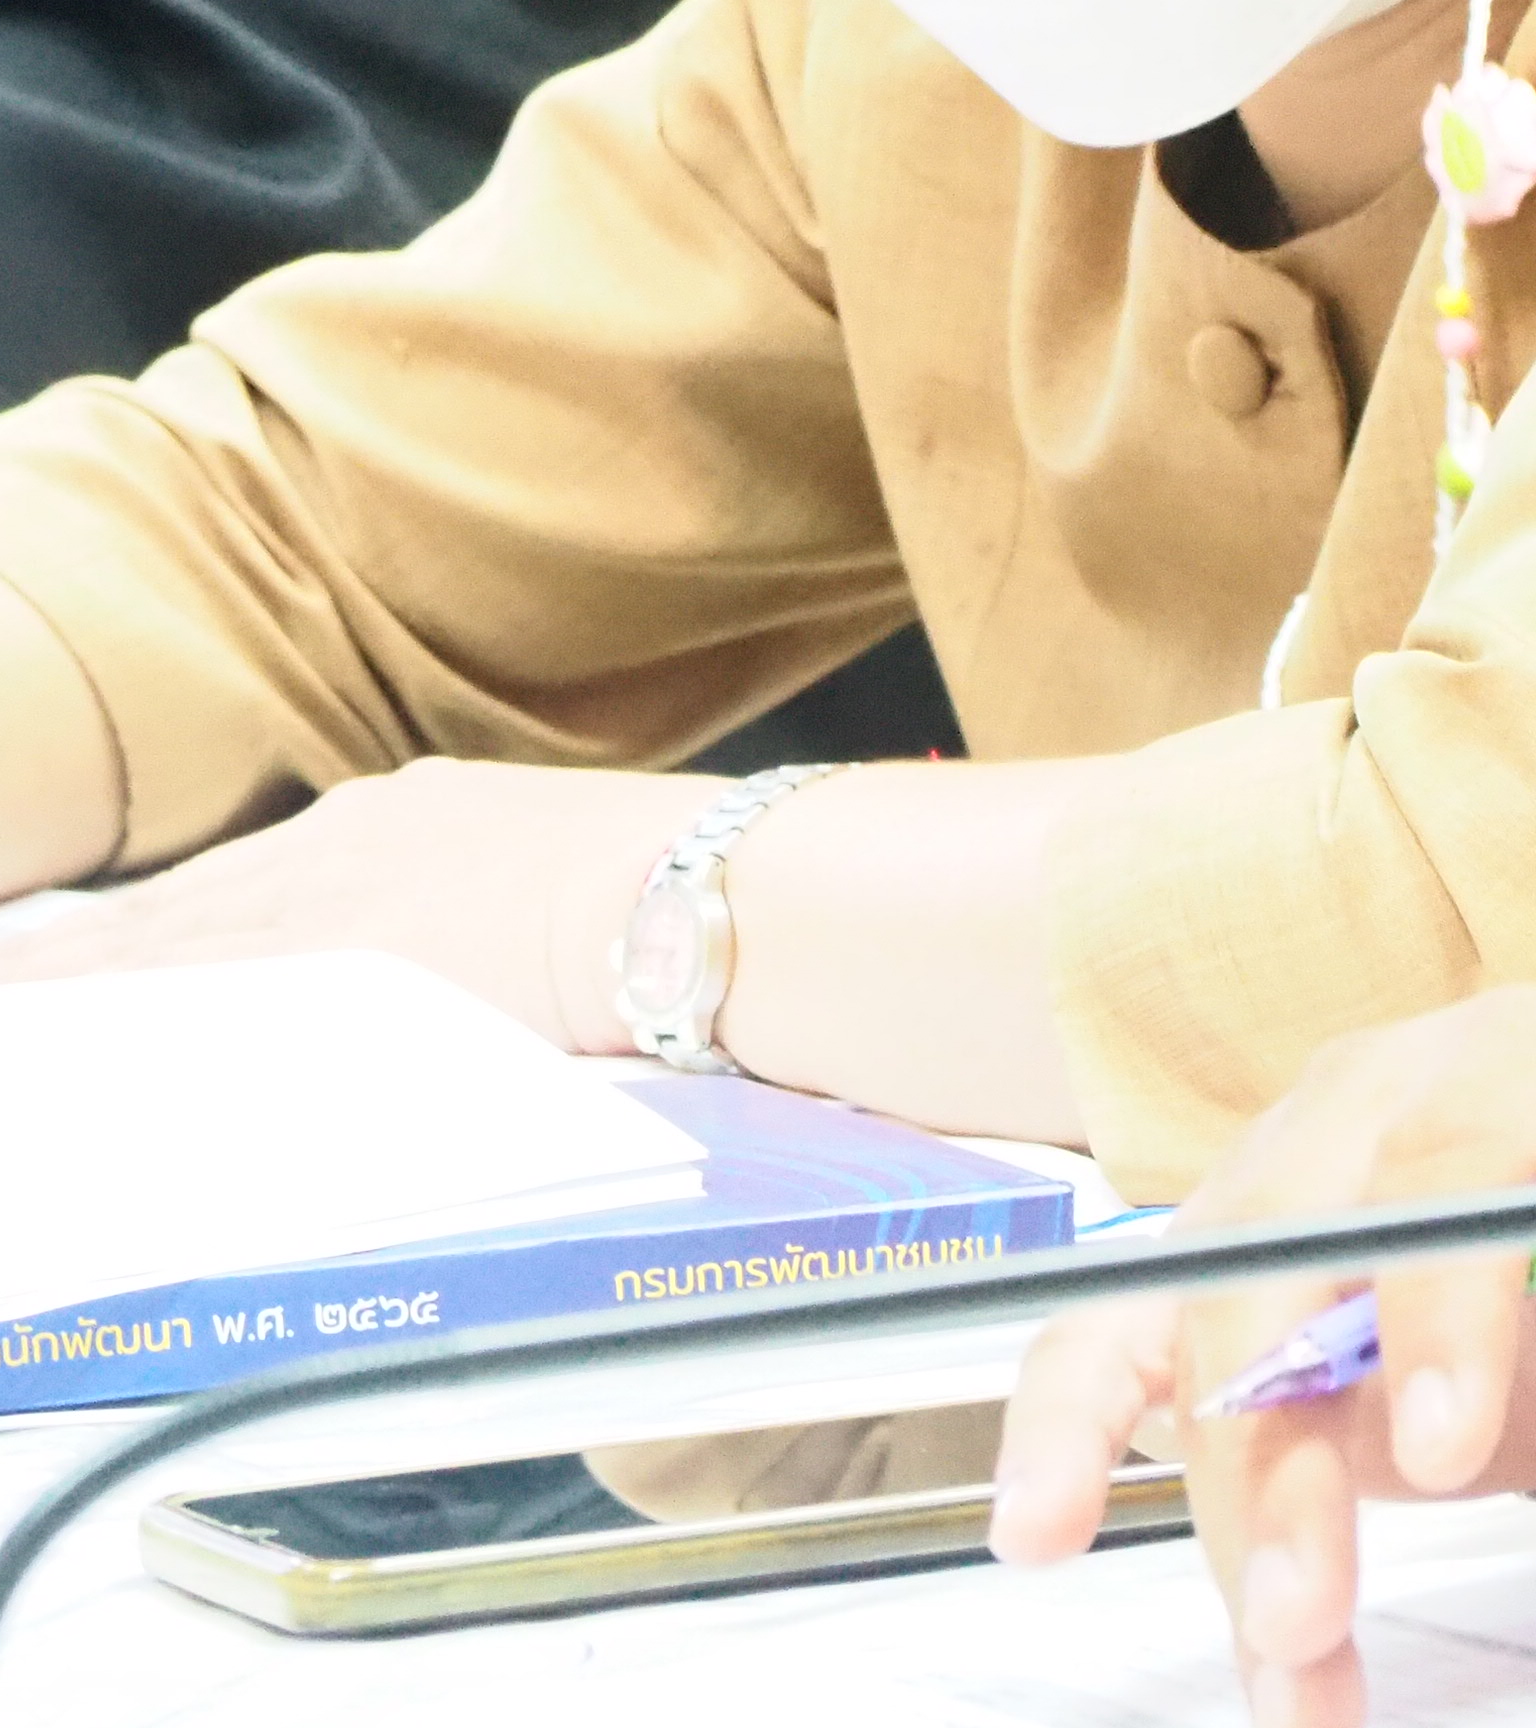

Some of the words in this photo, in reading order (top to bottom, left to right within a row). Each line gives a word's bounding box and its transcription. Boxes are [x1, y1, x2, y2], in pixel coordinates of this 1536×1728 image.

[613, 1233, 1004, 1302] กรมการพัฒนาชมชน
[212, 1305, 295, 1346] พ.ศ.
[315, 1289, 441, 1335] ๒๕๖๕
